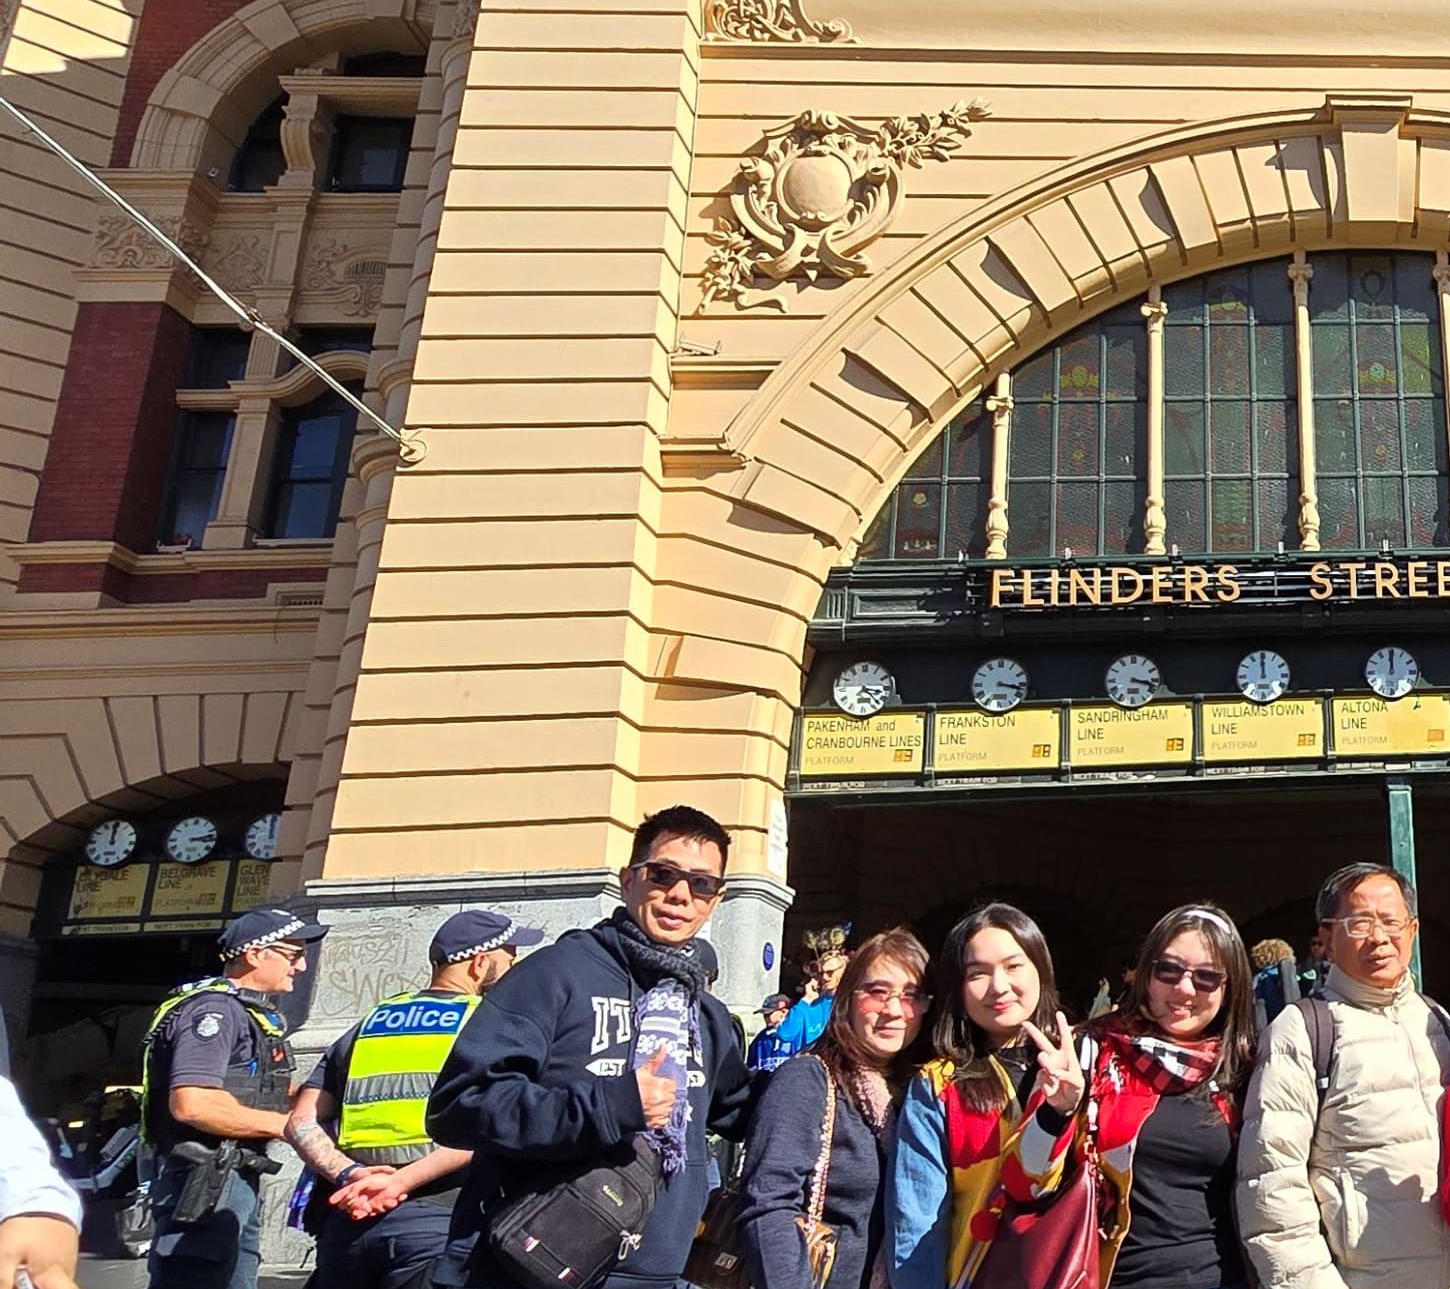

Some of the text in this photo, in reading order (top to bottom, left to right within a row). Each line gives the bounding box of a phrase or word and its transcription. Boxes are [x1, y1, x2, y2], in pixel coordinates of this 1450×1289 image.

[991, 565, 1241, 608] FLINDERS
[1212, 705, 1305, 718] WILLIAMSTOWN
[1341, 701, 1388, 713] ALTONA
[940, 714, 1017, 728] FRANKSTON
[1078, 709, 1168, 724] SANDRINGHAM
[808, 719, 897, 733] PAKENHAM and
[1211, 723, 1238, 735] LINE
[1341, 718, 1367, 729] LINE
[939, 733, 967, 745] LINE
[1078, 728, 1104, 740] LINE
[1342, 735, 1388, 745] PLATFORM
[807, 734, 921, 750] CRANBOURNE LINES
[1211, 740, 1258, 751] PLATFORM
[939, 752, 988, 762] PLATFORM
[1078, 746, 1125, 756] PLATFORM
[806, 756, 854, 766] PLATFORM
[160, 865, 217, 879] BELGRAVE
[77, 882, 101, 893] LINE
[158, 878, 183, 889] LINE
[237, 886, 261, 897] LINE
[367, 1006, 460, 1031] Police
